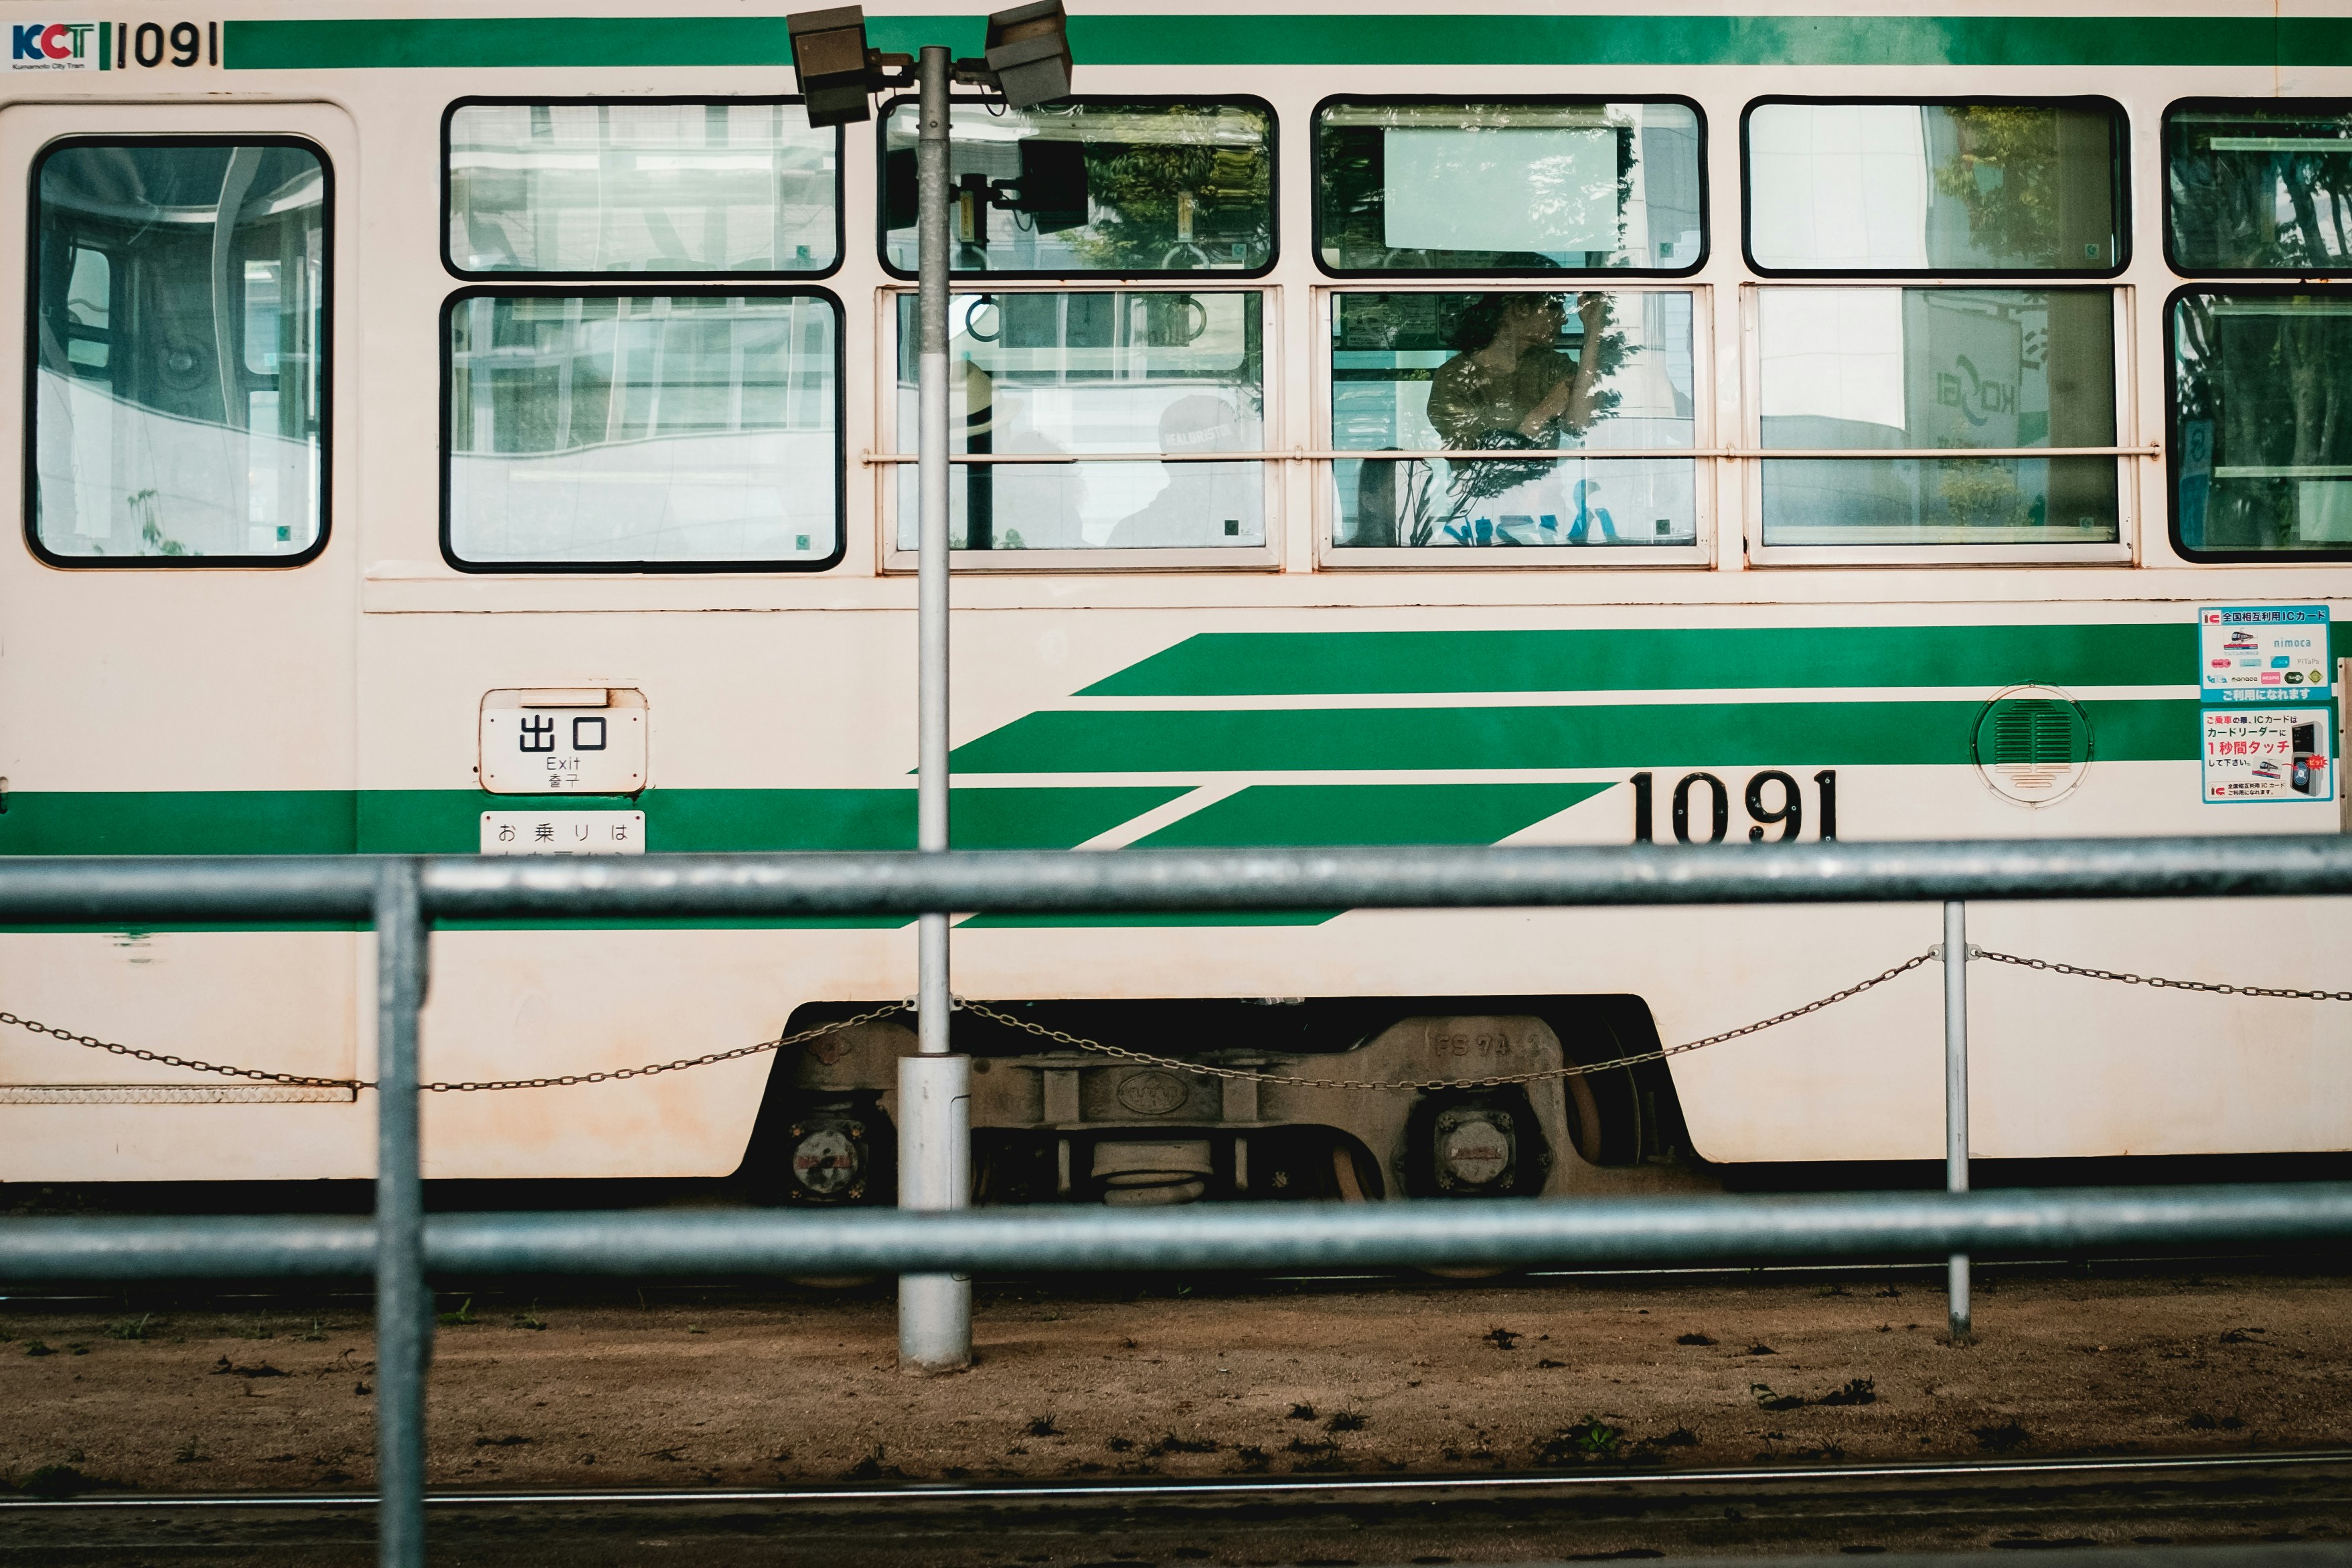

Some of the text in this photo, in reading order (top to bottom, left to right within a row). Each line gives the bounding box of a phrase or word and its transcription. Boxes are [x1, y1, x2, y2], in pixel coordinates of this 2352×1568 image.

[13, 23, 94, 59] KCT
[117, 21, 218, 69] 1091
[2222, 610, 2325, 623] 全国相互利用ICカード
[2274, 638, 2311, 647] nimoca
[2223, 689, 2310, 701] ご利用になれます
[520, 714, 607, 753] 出口
[2207, 726, 2287, 737] カードリーダーに
[2207, 740, 2290, 755] 1秒間タッチ
[546, 757, 580, 771] Exit
[548, 774, 580, 788] 출구
[1630, 770, 1836, 845] 1091
[499, 823, 628, 842] お乗りは
